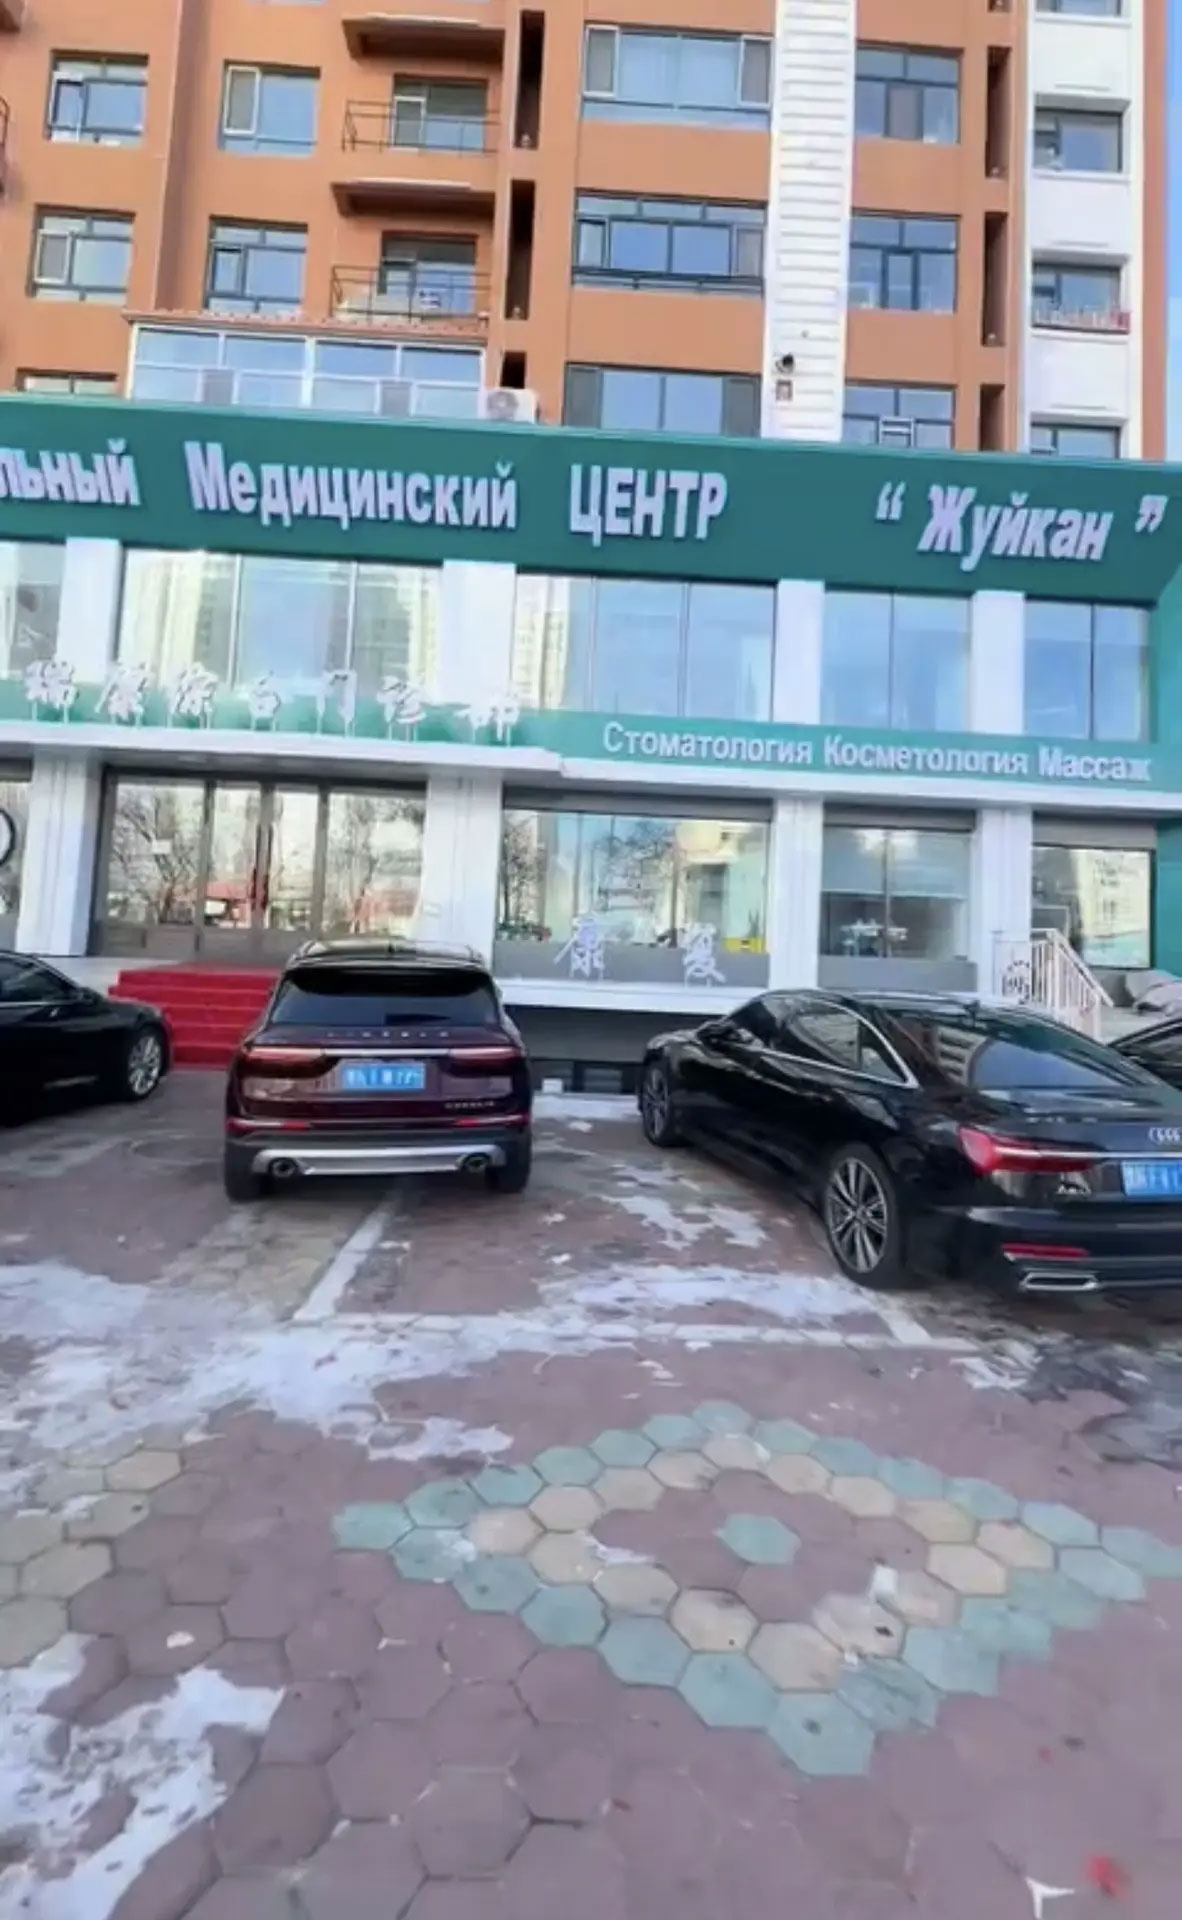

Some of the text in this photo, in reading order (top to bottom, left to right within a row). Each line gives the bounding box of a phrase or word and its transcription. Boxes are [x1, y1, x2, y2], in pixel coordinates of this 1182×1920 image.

[184, 441, 518, 531] Медицинский
[568, 463, 729, 547] ЦЕНТР
[602, 721, 1152, 782] Стоматология Косметология Массаж
